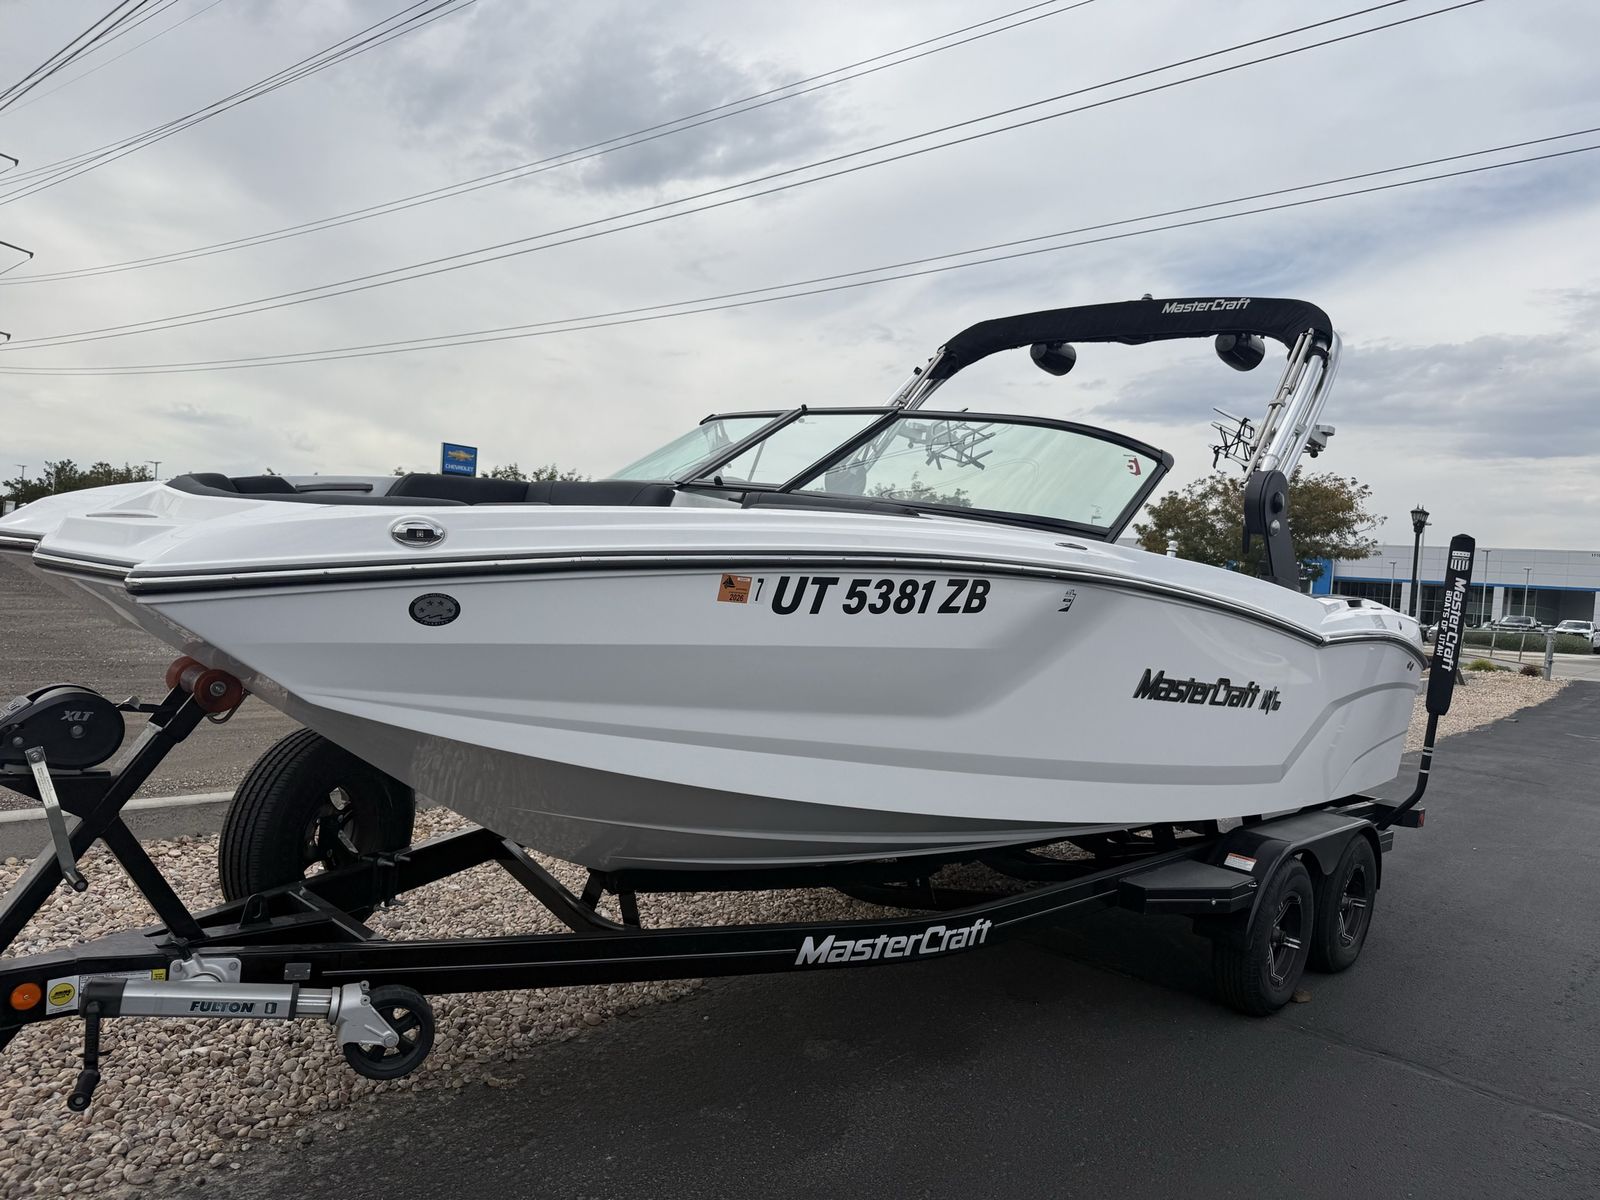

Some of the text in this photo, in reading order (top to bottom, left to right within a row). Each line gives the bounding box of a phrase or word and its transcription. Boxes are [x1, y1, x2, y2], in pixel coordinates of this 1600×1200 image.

[1161, 298, 1250, 314] MasterCraft
[755, 578, 764, 602] 7
[771, 576, 991, 615] UT 5381 ZB
[1436, 590, 1453, 656] BOATS OF UTAH
[1441, 577, 1467, 672] MasterCraft
[1132, 668, 1261, 708] MasterCraft
[60, 710, 94, 722] XLT
[795, 918, 993, 965] MasterCraft
[190, 1001, 255, 1013] FULTON
